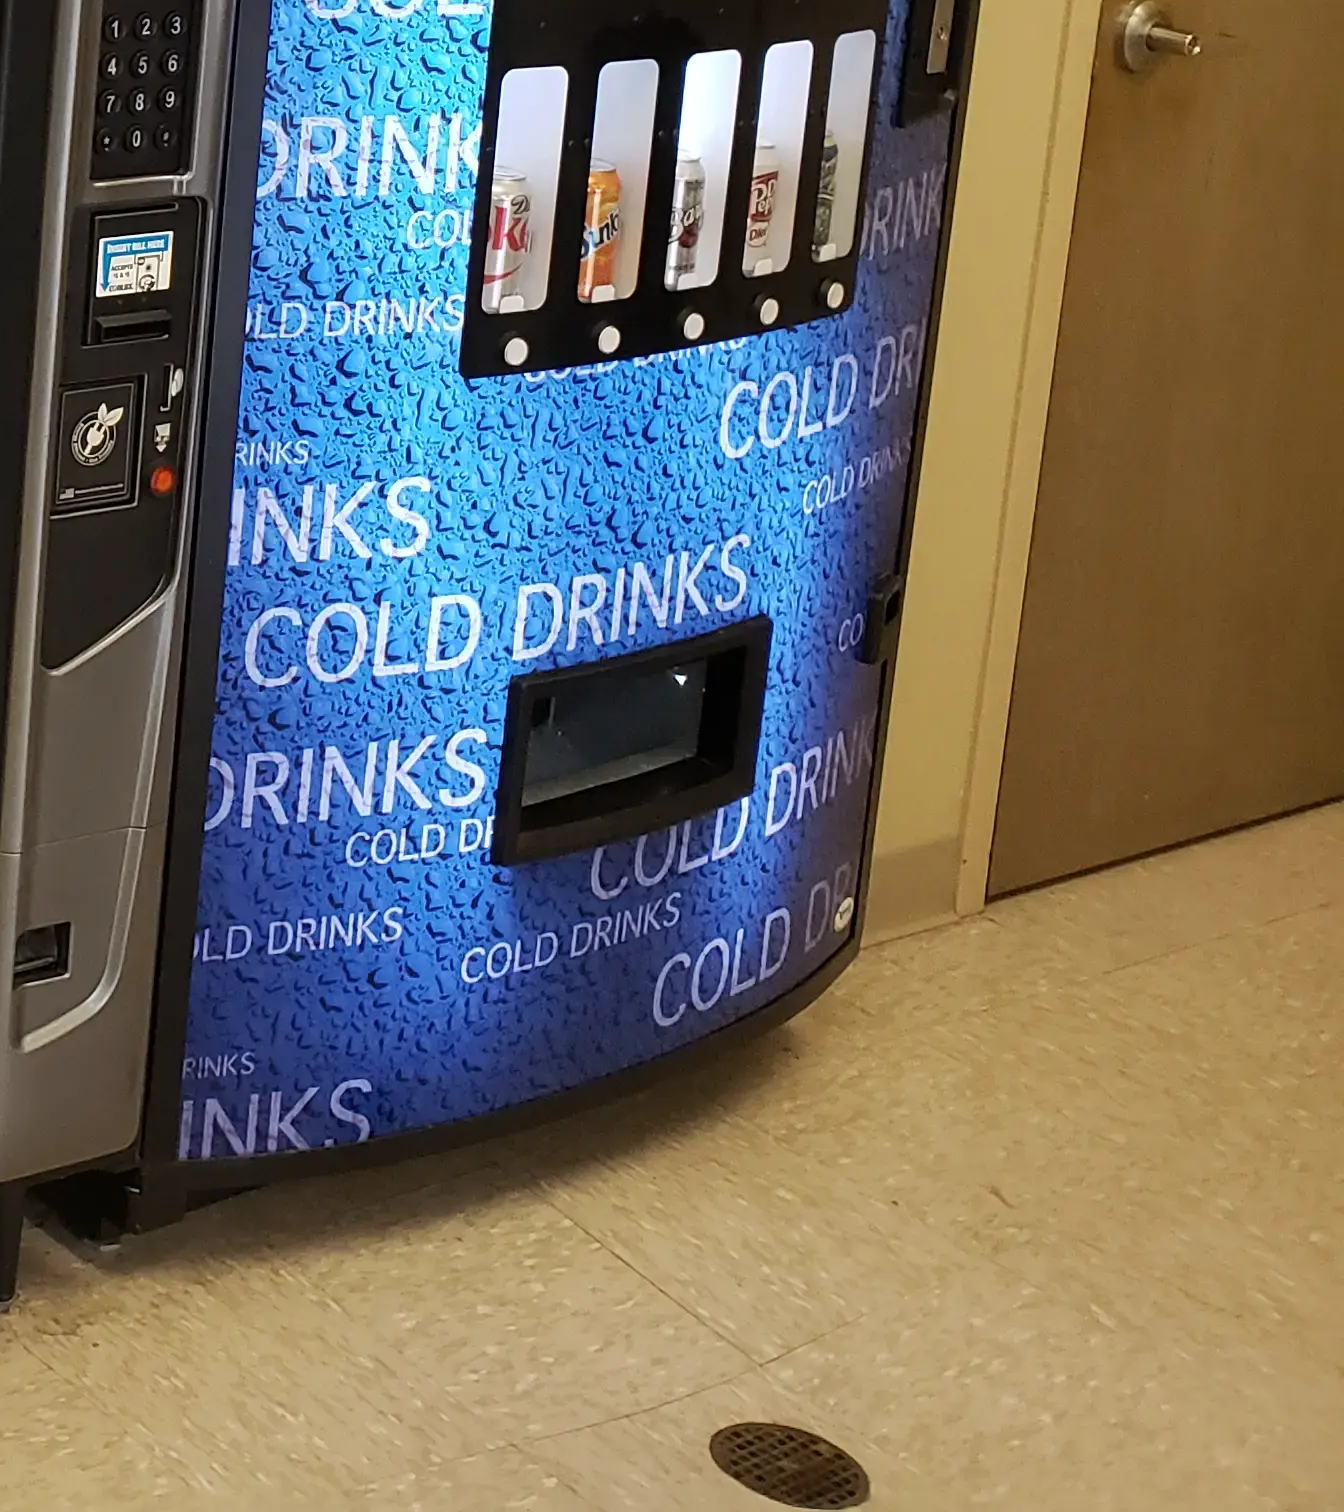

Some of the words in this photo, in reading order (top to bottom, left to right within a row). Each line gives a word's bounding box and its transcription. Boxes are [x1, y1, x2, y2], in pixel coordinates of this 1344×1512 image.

[324, 295, 465, 337] DRINKS
[720, 355, 859, 460] COLD
[803, 466, 854, 514] COLD
[244, 593, 479, 689] COLD
[512, 534, 751, 663] DRINKS
[345, 822, 445, 868] COLD
[266, 907, 403, 956] DRINKS
[461, 932, 558, 983] COLD
[569, 891, 682, 957] DRINKS
[653, 905, 790, 1028] COLD
